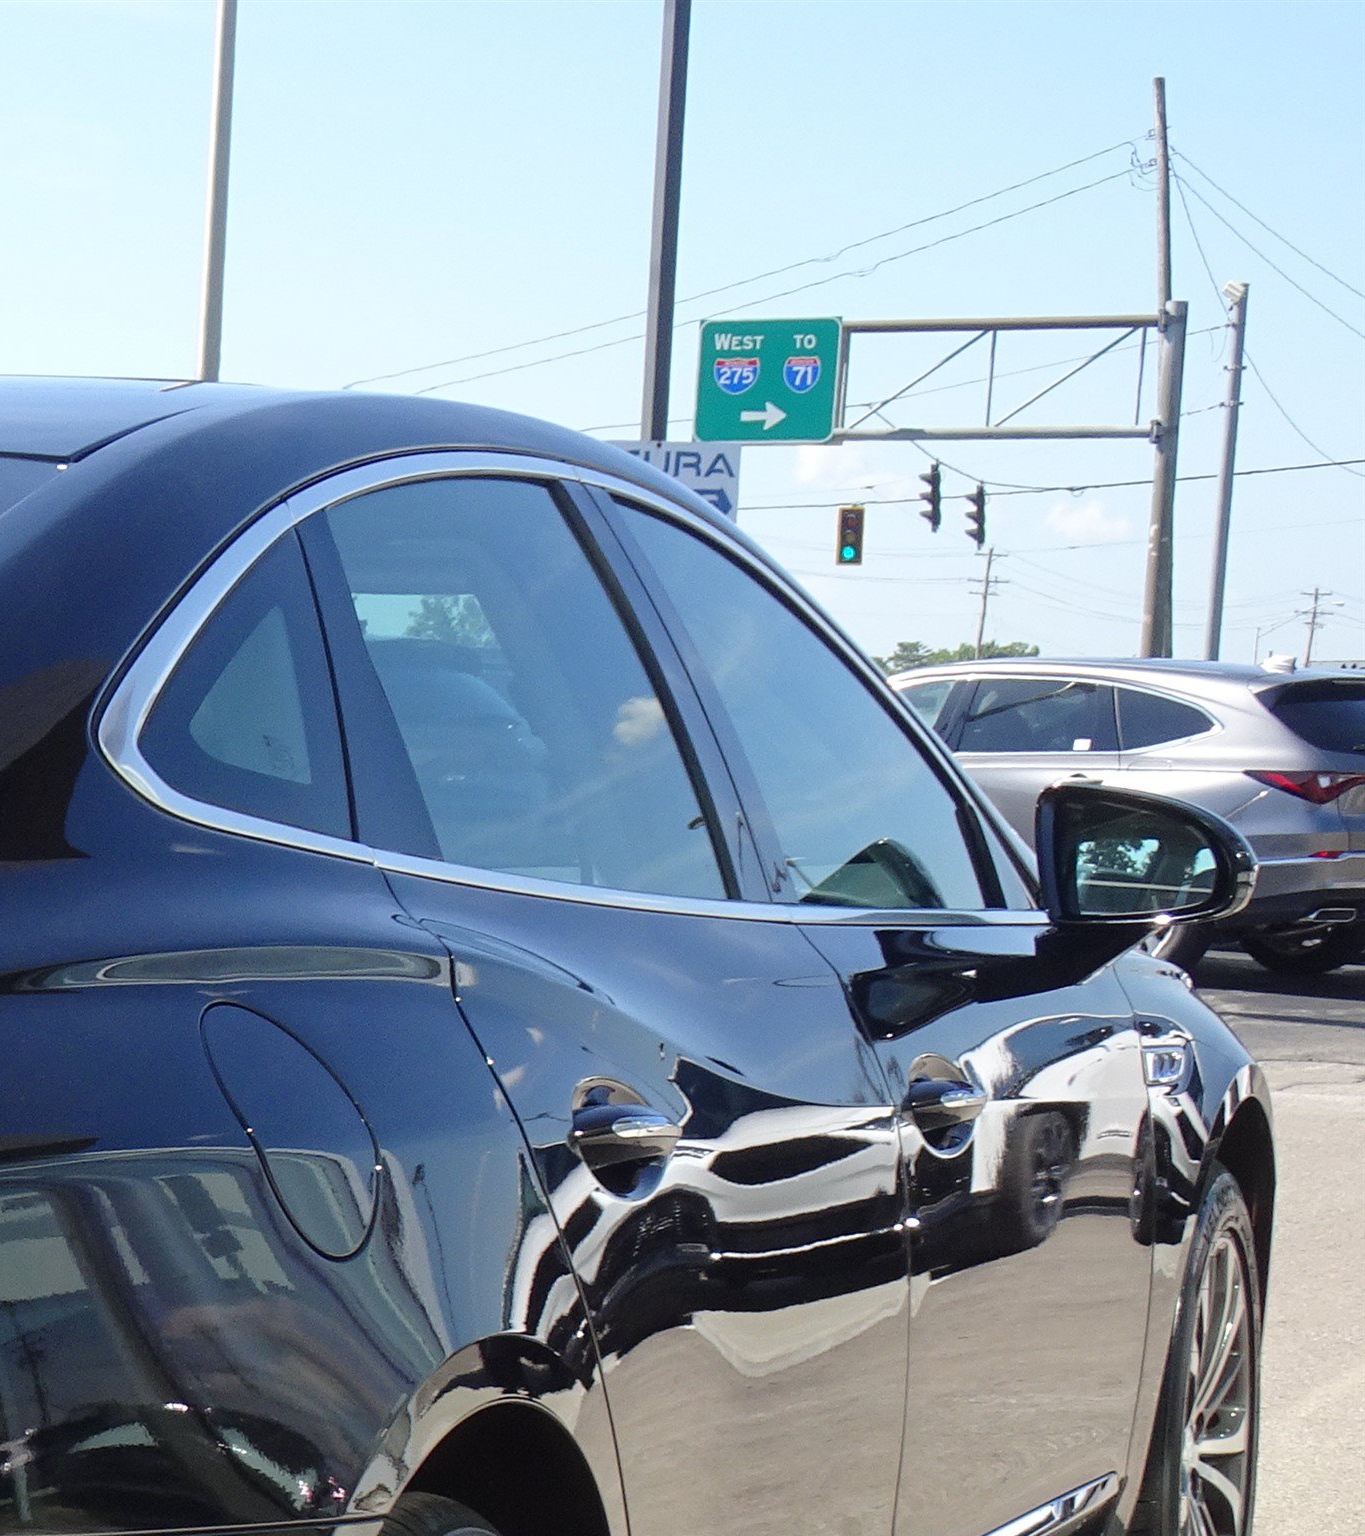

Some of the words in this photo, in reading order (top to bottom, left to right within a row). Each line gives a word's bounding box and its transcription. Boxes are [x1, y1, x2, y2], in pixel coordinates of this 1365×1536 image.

[714, 333, 765, 351] WEST
[793, 334, 818, 350] TO
[719, 367, 755, 385] 275
[792, 366, 813, 386] 71
[628, 449, 735, 478] URA
